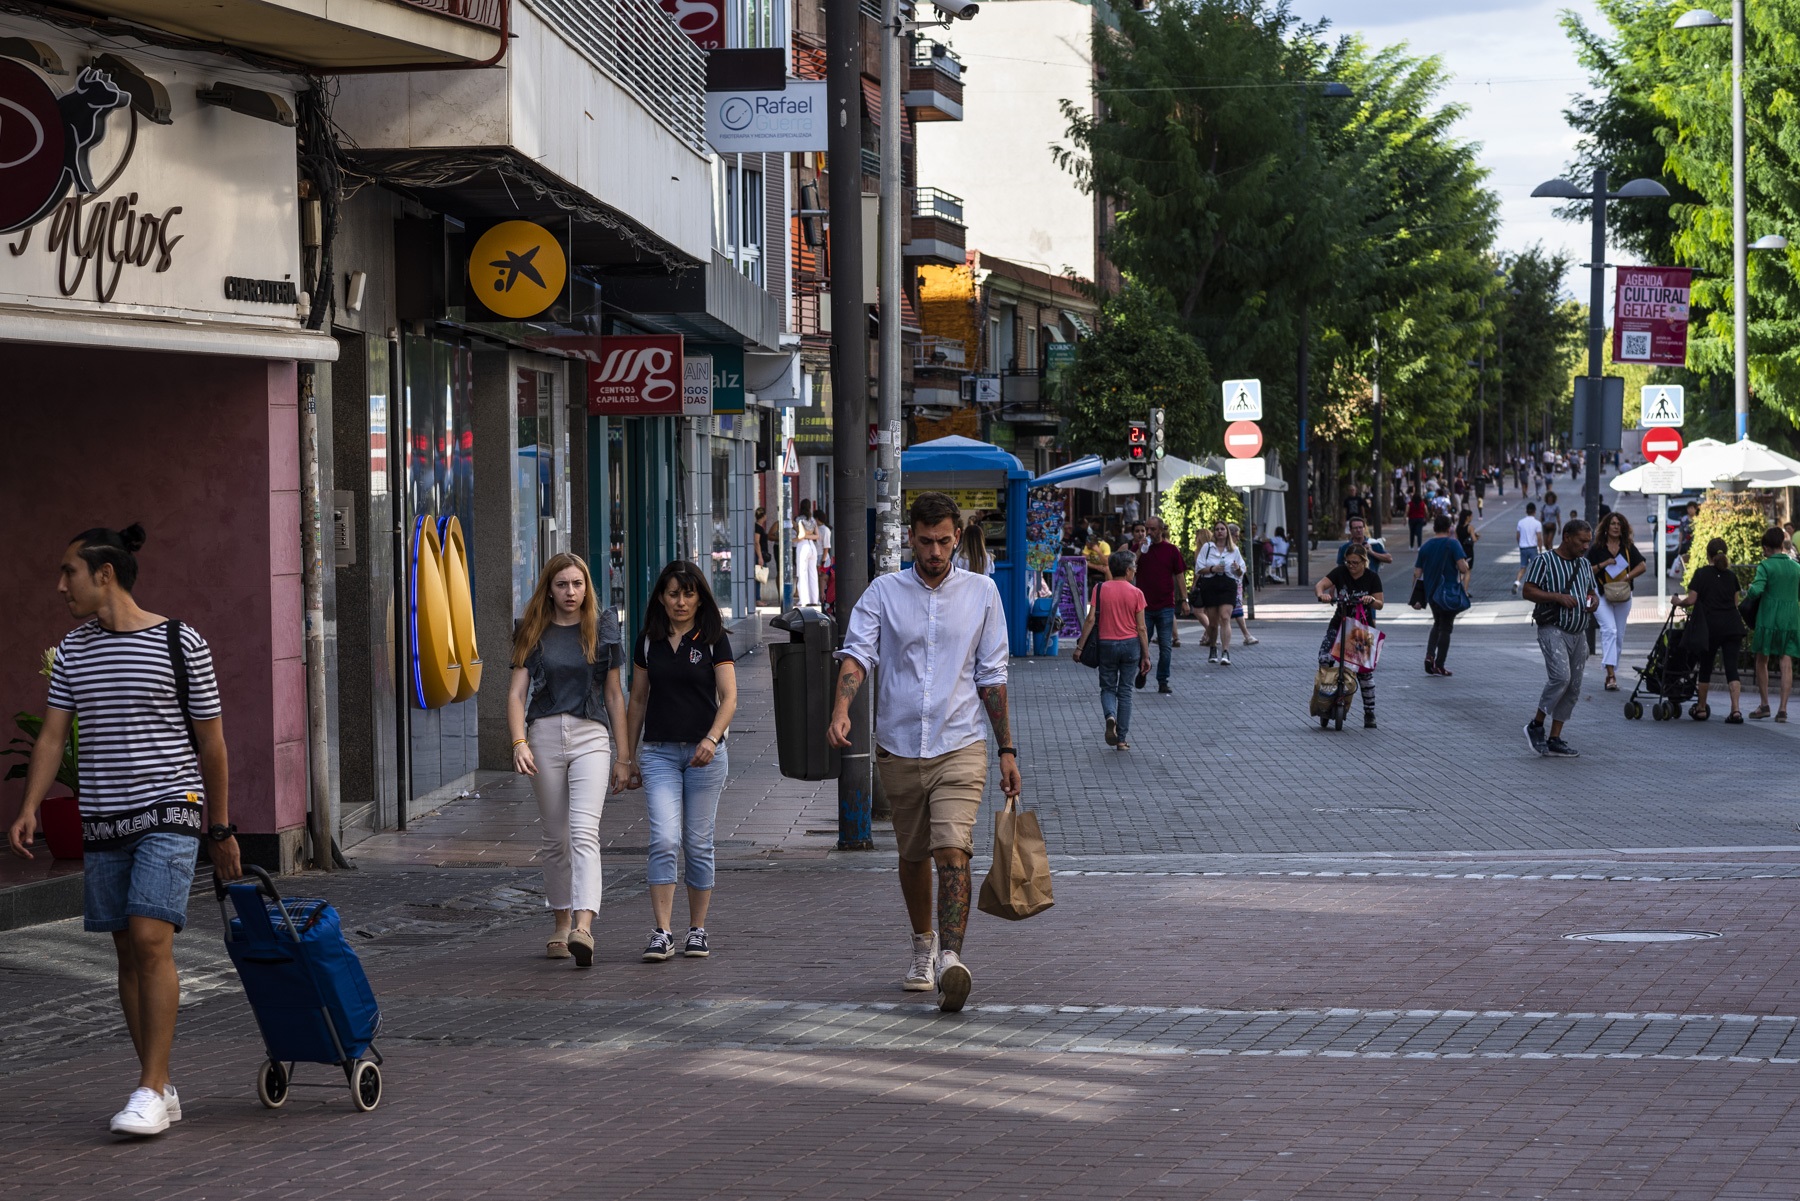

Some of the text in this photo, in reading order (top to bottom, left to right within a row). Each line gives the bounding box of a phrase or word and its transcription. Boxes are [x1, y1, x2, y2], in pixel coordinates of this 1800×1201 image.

[756, 96, 812, 114] Rafael
[756, 115, 812, 131] Guerra
[1625, 274, 1663, 287] AGENDA
[224, 274, 298, 304] CHARCUTERÍA
[1624, 287, 1686, 304] CULTURAL
[1623, 303, 1667, 318] GETAFE
[600, 386, 636, 394] CENTROS
[596, 395, 640, 403] CAPILARES
[82, 807, 201, 841] ALVIN KLEIN JEANS
